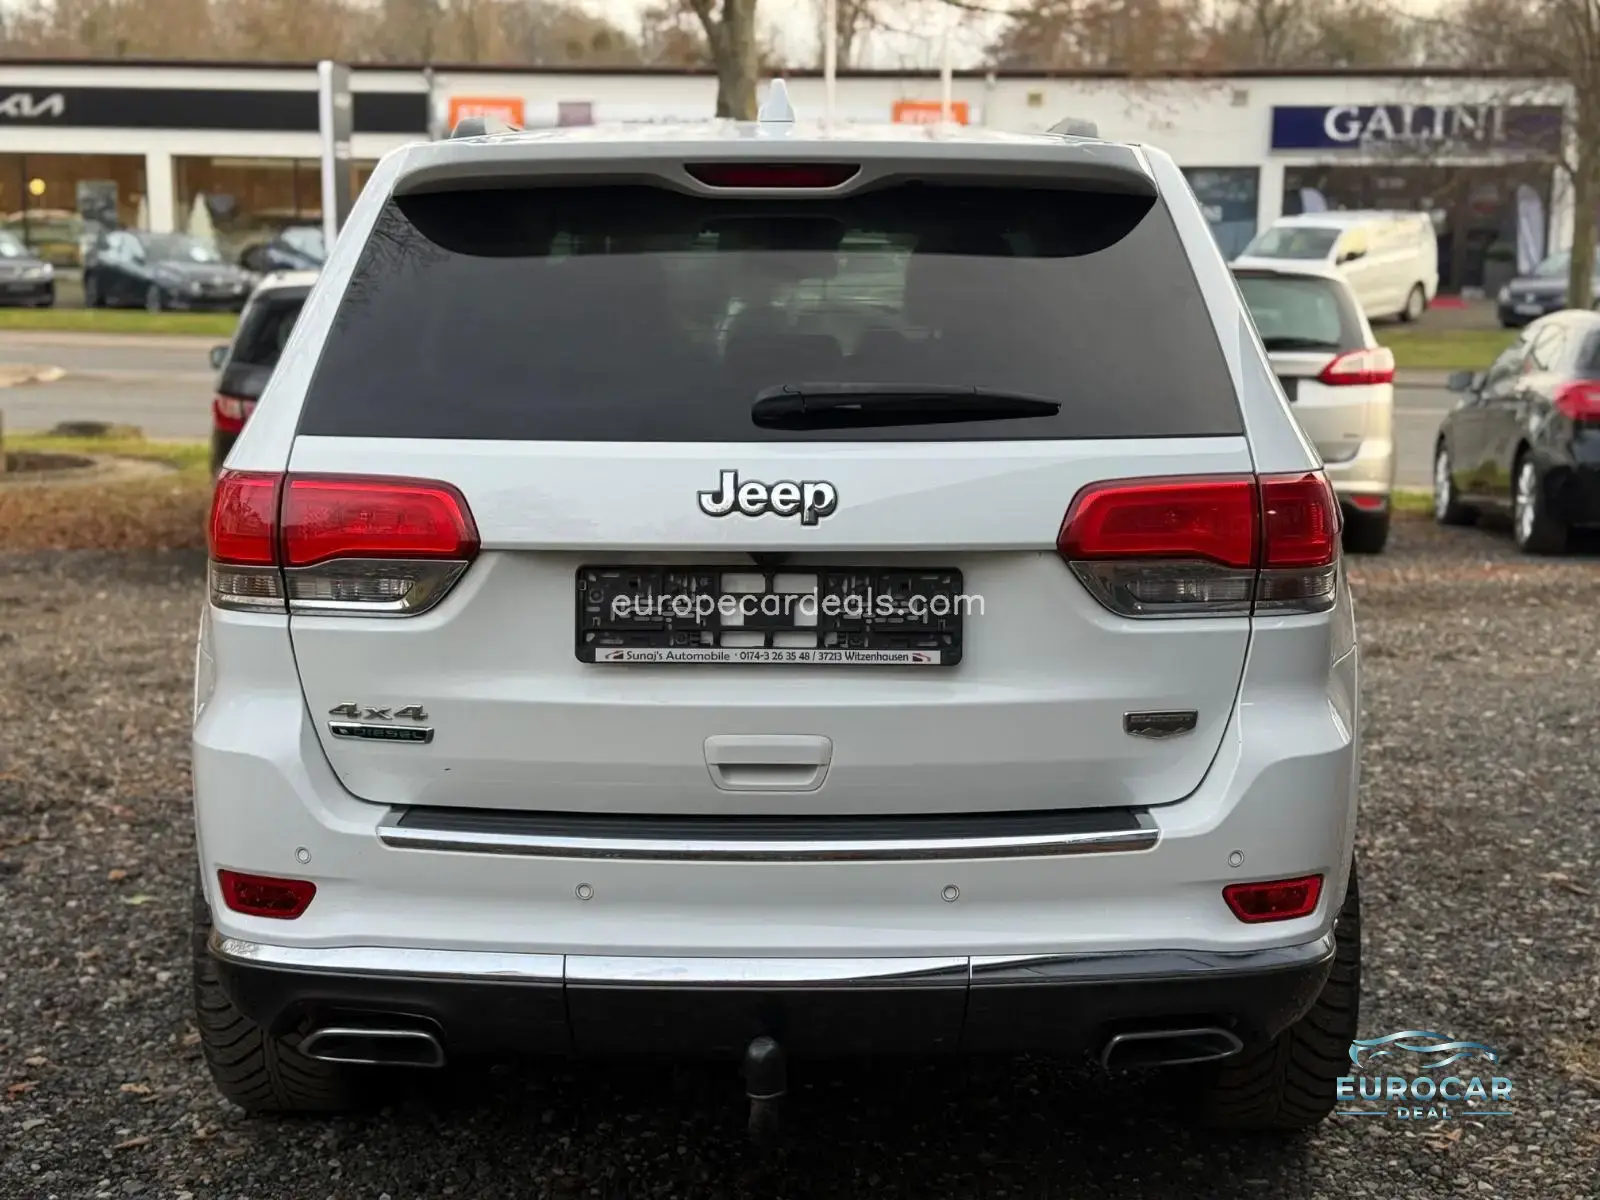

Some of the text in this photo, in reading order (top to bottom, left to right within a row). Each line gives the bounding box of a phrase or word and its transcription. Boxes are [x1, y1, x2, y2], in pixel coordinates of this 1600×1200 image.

[1323, 106, 1507, 141] GALINI
[697, 469, 838, 525] Jeep
[626, 651, 663, 662] Sunaj's
[666, 651, 730, 660] Automobile
[740, 651, 769, 661] 0174-3
[772, 651, 783, 661] 26
[786, 651, 796, 661] 35
[799, 651, 810, 661] 48
[818, 652, 842, 661] 37213
[845, 651, 909, 661] Witzenhausen
[328, 702, 429, 721] 4x4
[353, 728, 425, 739] DIESEL
